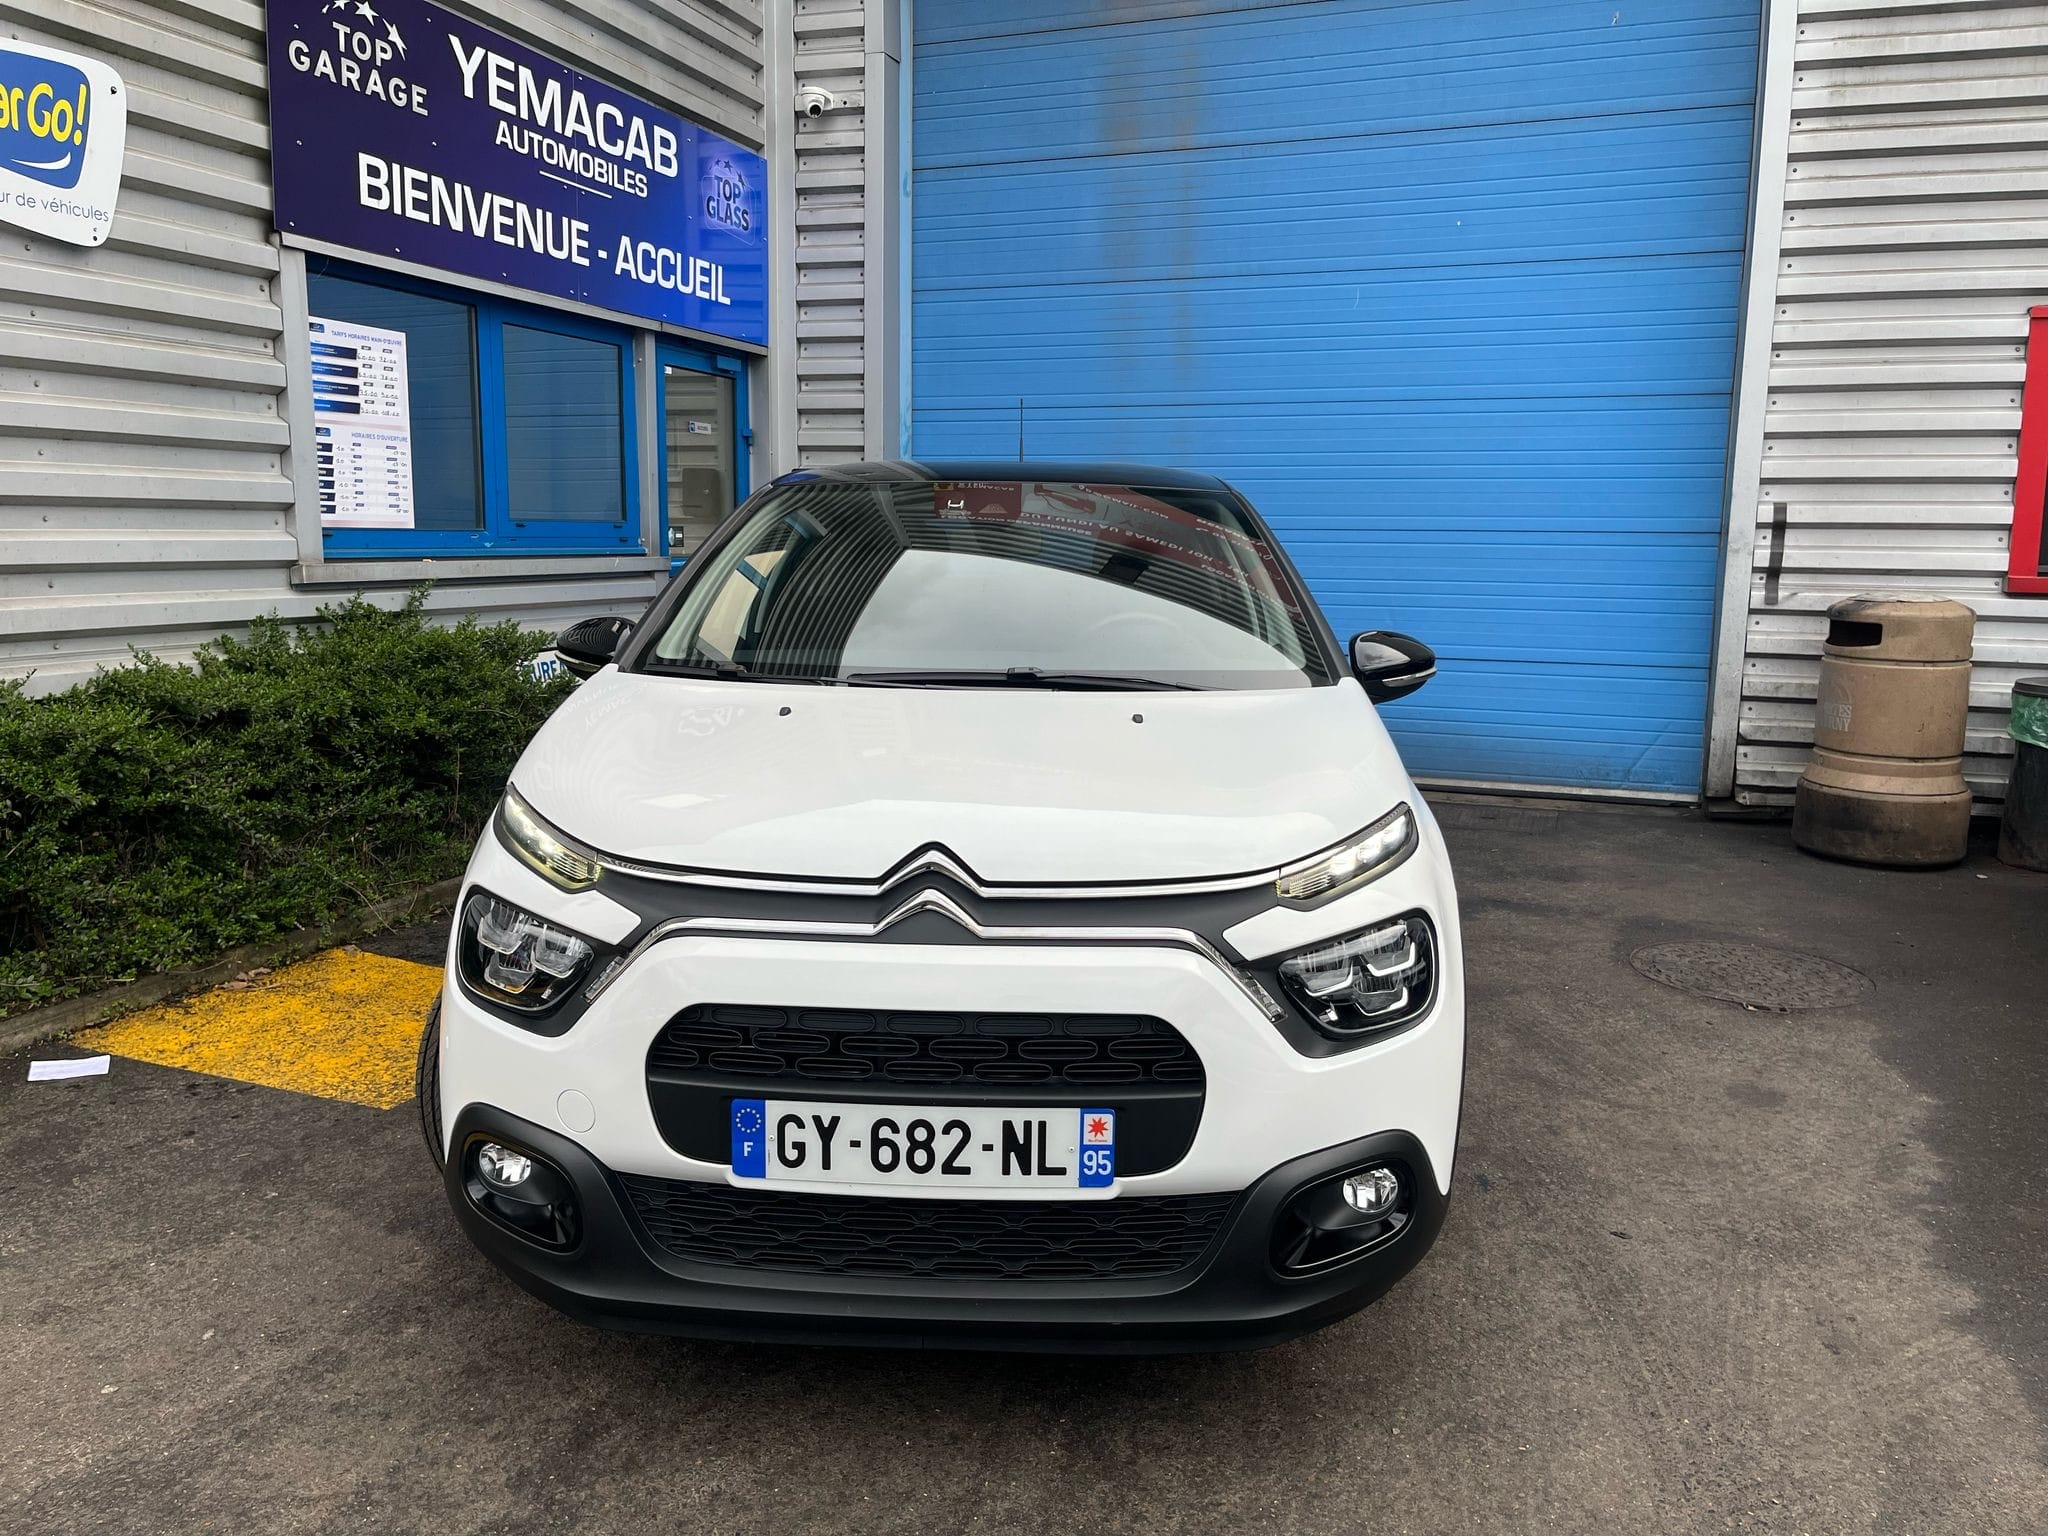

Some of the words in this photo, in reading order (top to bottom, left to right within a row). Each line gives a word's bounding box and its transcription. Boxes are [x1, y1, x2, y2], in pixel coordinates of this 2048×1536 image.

[332, 21, 393, 67] TOP
[288, 39, 429, 117] GARAGE
[448, 34, 679, 178] YEMACAB
[495, 120, 648, 198] AUTOMOBILES
[15, 191, 36, 208] de
[41, 197, 109, 222] véhicules
[714, 175, 742, 204] TOP
[358, 152, 590, 267] BIENVENUE
[615, 235, 731, 305] ACCUEIL
[706, 195, 750, 232] GLASS
[743, 1141, 754, 1157] F
[776, 1113, 1067, 1176] GY-682-NL
[1082, 1150, 1112, 1175] 95
